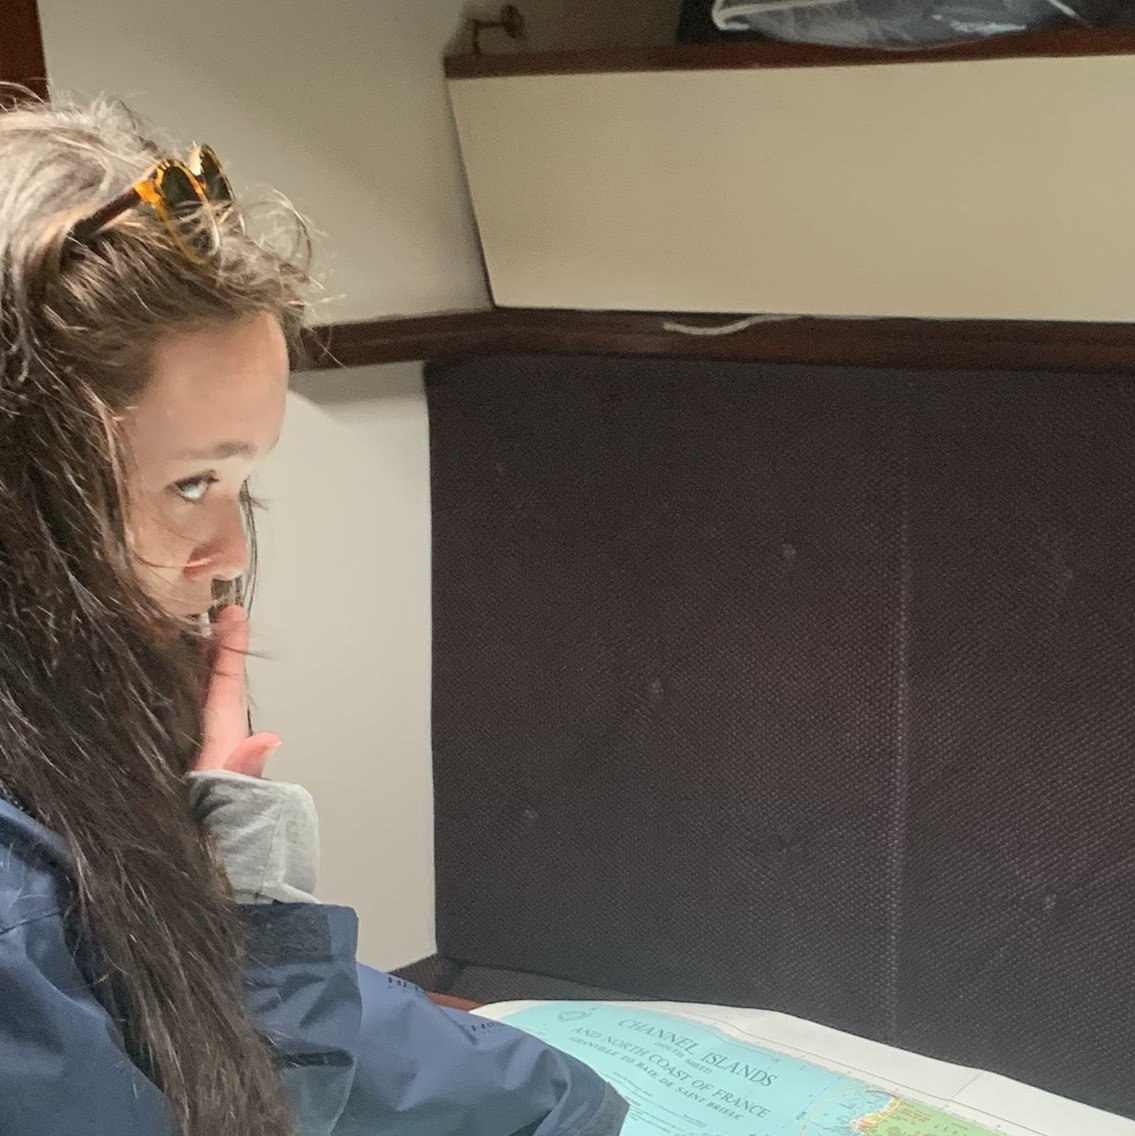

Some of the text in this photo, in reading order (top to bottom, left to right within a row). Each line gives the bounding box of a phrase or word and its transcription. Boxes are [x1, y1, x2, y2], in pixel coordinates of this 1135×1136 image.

[571, 1027, 771, 1119] AND NORTH COAST OF FRANCE
[618, 1018, 778, 1087] CHANNEL ISLANDS
[621, 1056, 636, 1064] TO
[658, 1076, 675, 1088] DE
[675, 1085, 706, 1104] SAINT
